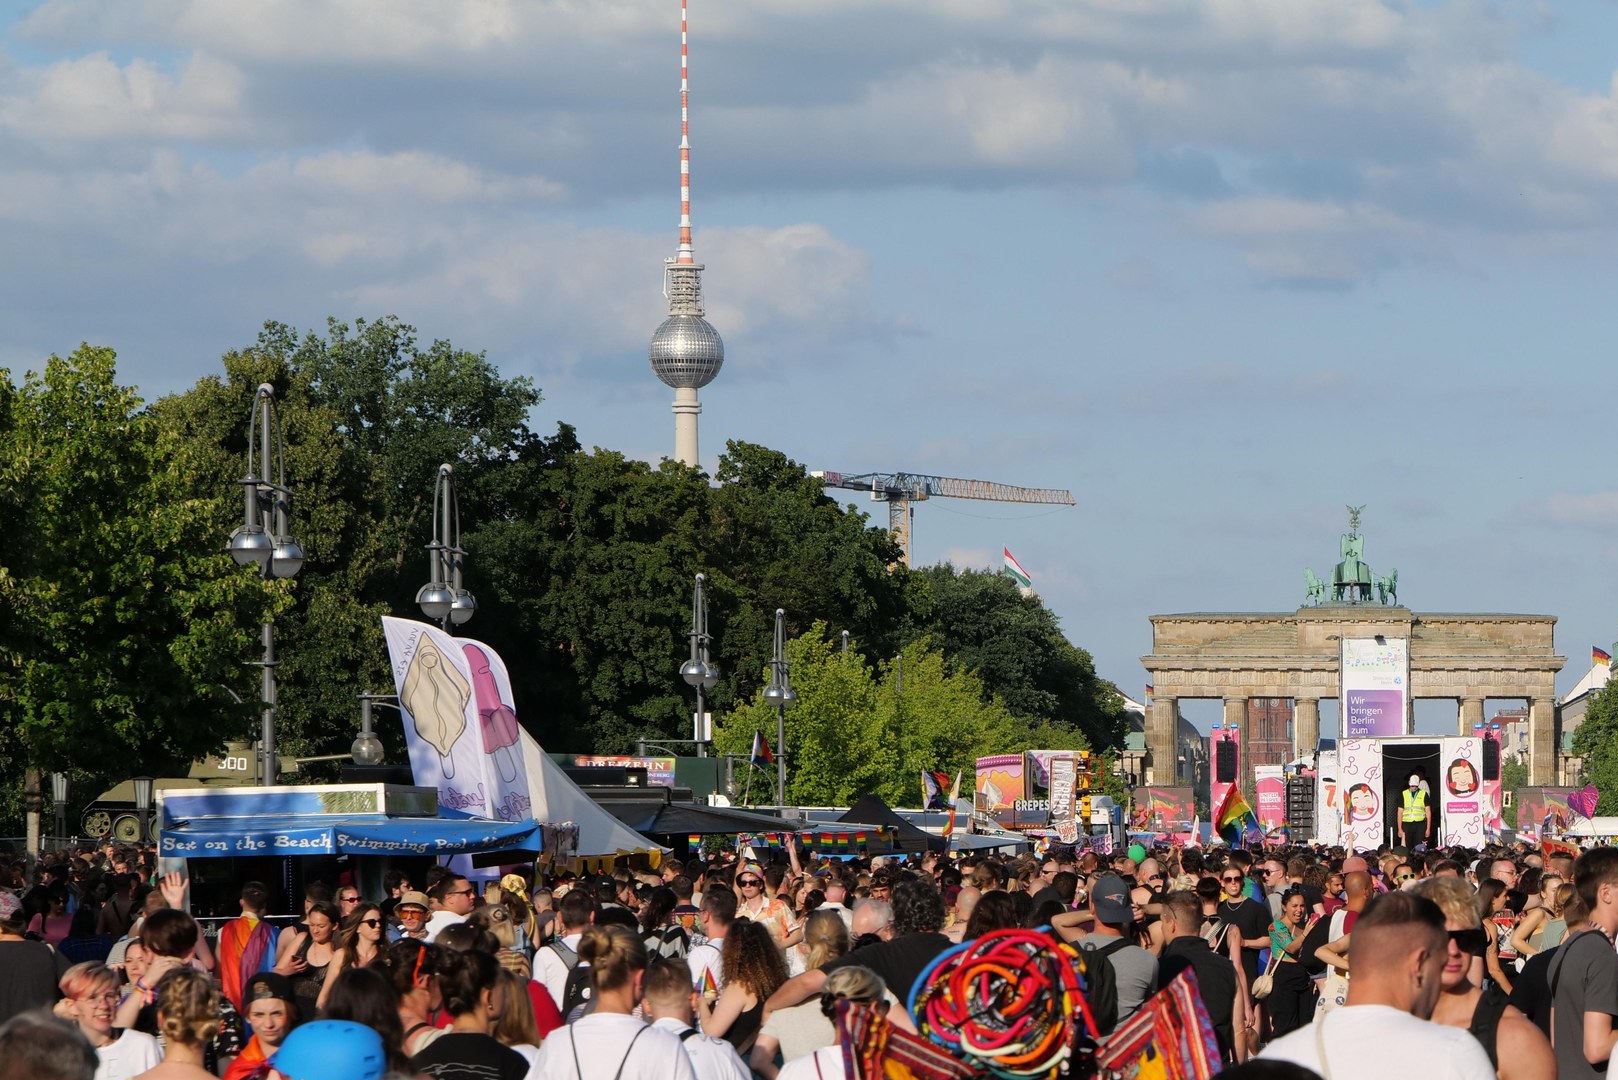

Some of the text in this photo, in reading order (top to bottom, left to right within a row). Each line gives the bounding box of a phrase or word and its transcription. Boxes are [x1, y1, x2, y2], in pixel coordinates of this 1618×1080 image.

[1350, 696, 1366, 705] Wir
[1350, 706, 1383, 717] bringen
[1350, 715, 1375, 725] Berlin
[1351, 727, 1368, 735] zum
[217, 756, 248, 771] 300
[1015, 800, 1050, 812] CREPES
[162, 837, 198, 851] Sex
[204, 841, 229, 850] on
[235, 836, 267, 850] the
[273, 834, 333, 848] Beach
[337, 835, 431, 853] Swimming
[434, 838, 466, 849] Pool
